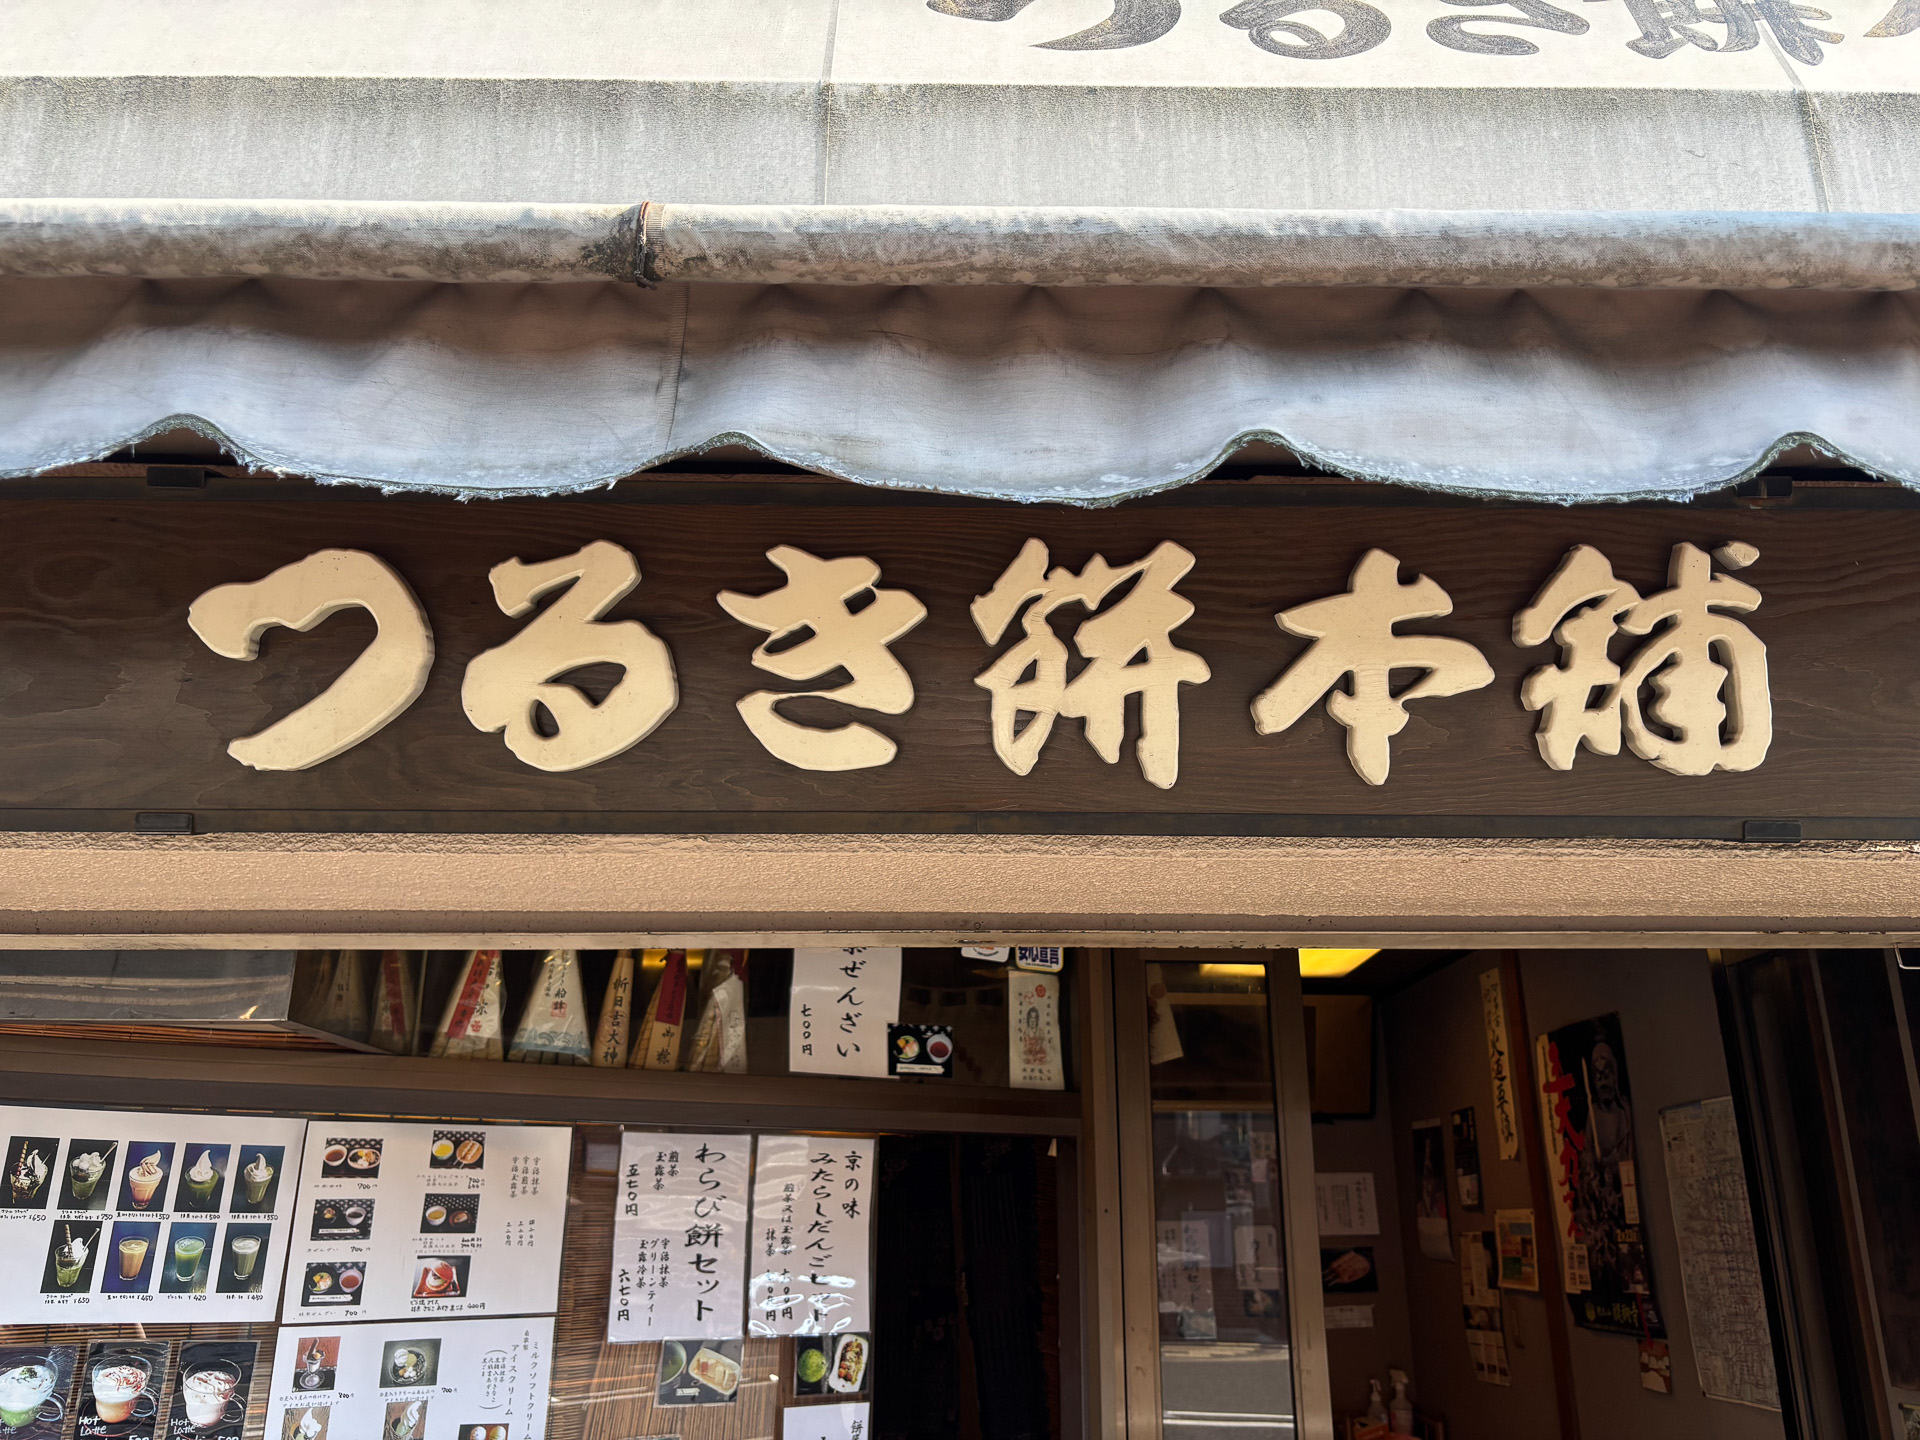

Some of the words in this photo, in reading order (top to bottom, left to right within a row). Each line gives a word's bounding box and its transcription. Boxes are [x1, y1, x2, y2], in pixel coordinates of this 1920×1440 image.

[187, 538, 1774, 788] つるき餅本舗
[801, 1003, 813, 1056] 七〇〇円
[625, 1164, 641, 1217] 五七〇円
[653, 1151, 668, 1191] 玉露茶
[667, 1151, 680, 1177] 煎茶
[842, 1150, 863, 1219] 京の味
[684, 1142, 728, 1322] わらび餅セット
[765, 1227, 777, 1257] 抹茶
[636, 1239, 649, 1289] 玉露冷茶
[647, 1238, 660, 1326] グリーンティー
[659, 1237, 671, 1288] 宇治抹茶
[617, 1268, 631, 1322] 六七〇円
[505, 1344, 520, 1416] アイスクリーム
[524, 1341, 540, 1440] ミルクソフトクリーム
[78, 1415, 101, 1426] Hot
[80, 1425, 107, 1436] Latte
[170, 1418, 190, 1427] Hot
